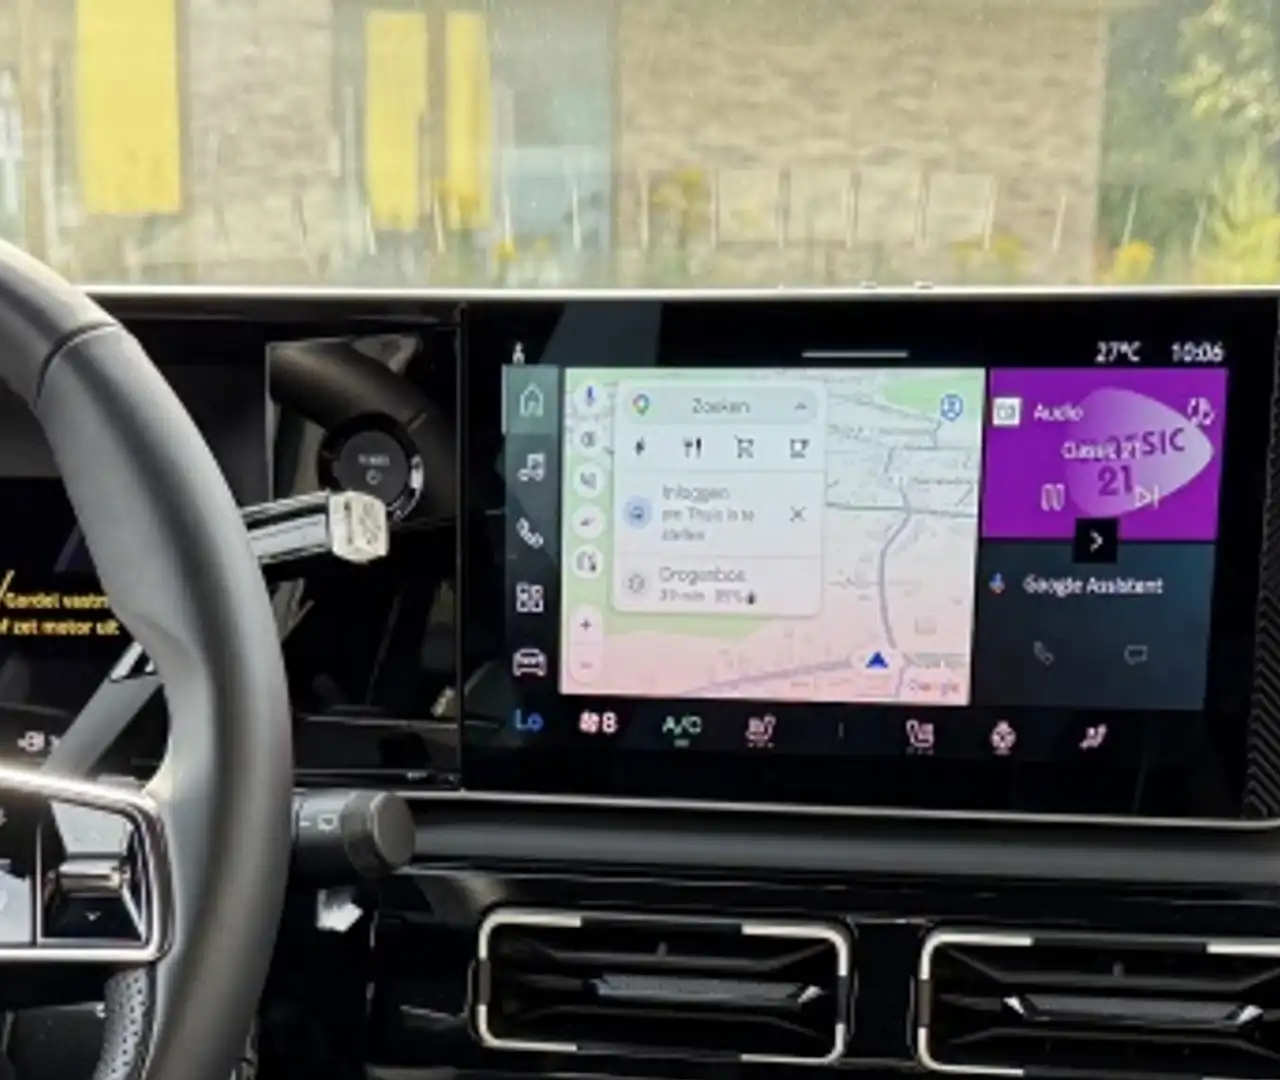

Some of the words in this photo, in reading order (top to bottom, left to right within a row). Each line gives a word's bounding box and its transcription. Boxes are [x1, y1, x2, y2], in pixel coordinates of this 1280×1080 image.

[1172, 341, 1224, 363] 10:06
[692, 397, 751, 414] Zoeken
[1033, 402, 1083, 422] Audio
[1097, 465, 1133, 497] 21
[1022, 573, 1083, 598] Google
[1086, 575, 1163, 594] Assistant
[5, 592, 61, 609] Gordel
[40, 620, 93, 635] motor
[514, 707, 544, 732] Lo
[662, 714, 702, 736] A/C
